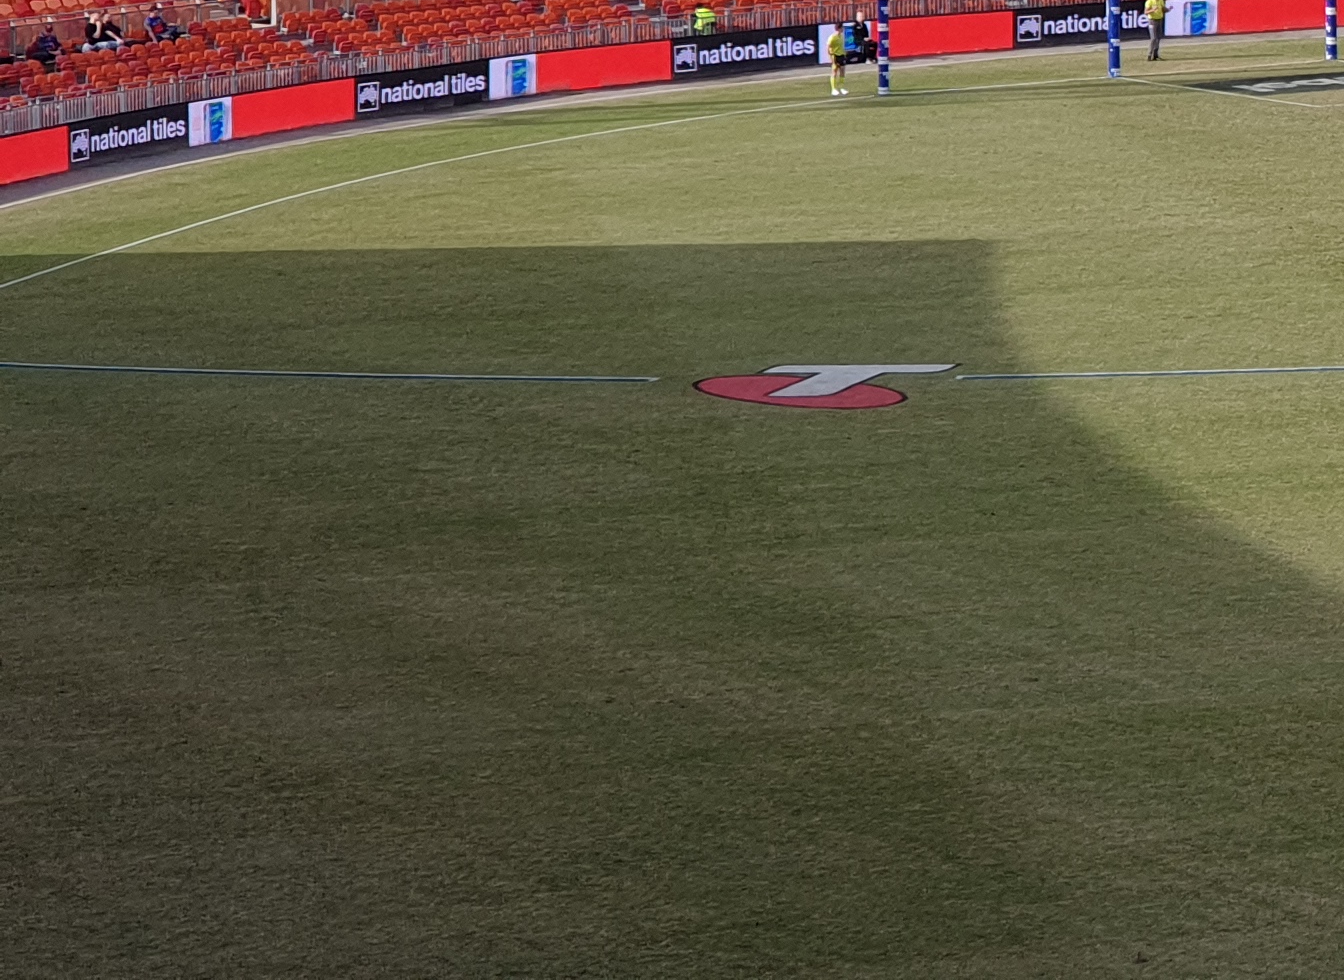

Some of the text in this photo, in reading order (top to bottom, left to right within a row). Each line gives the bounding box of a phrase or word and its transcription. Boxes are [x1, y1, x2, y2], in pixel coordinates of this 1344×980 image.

[1121, 9, 1149, 30] tile
[700, 36, 815, 65] national tiles
[380, 73, 486, 104] national tiles
[91, 117, 185, 152] national tiles
